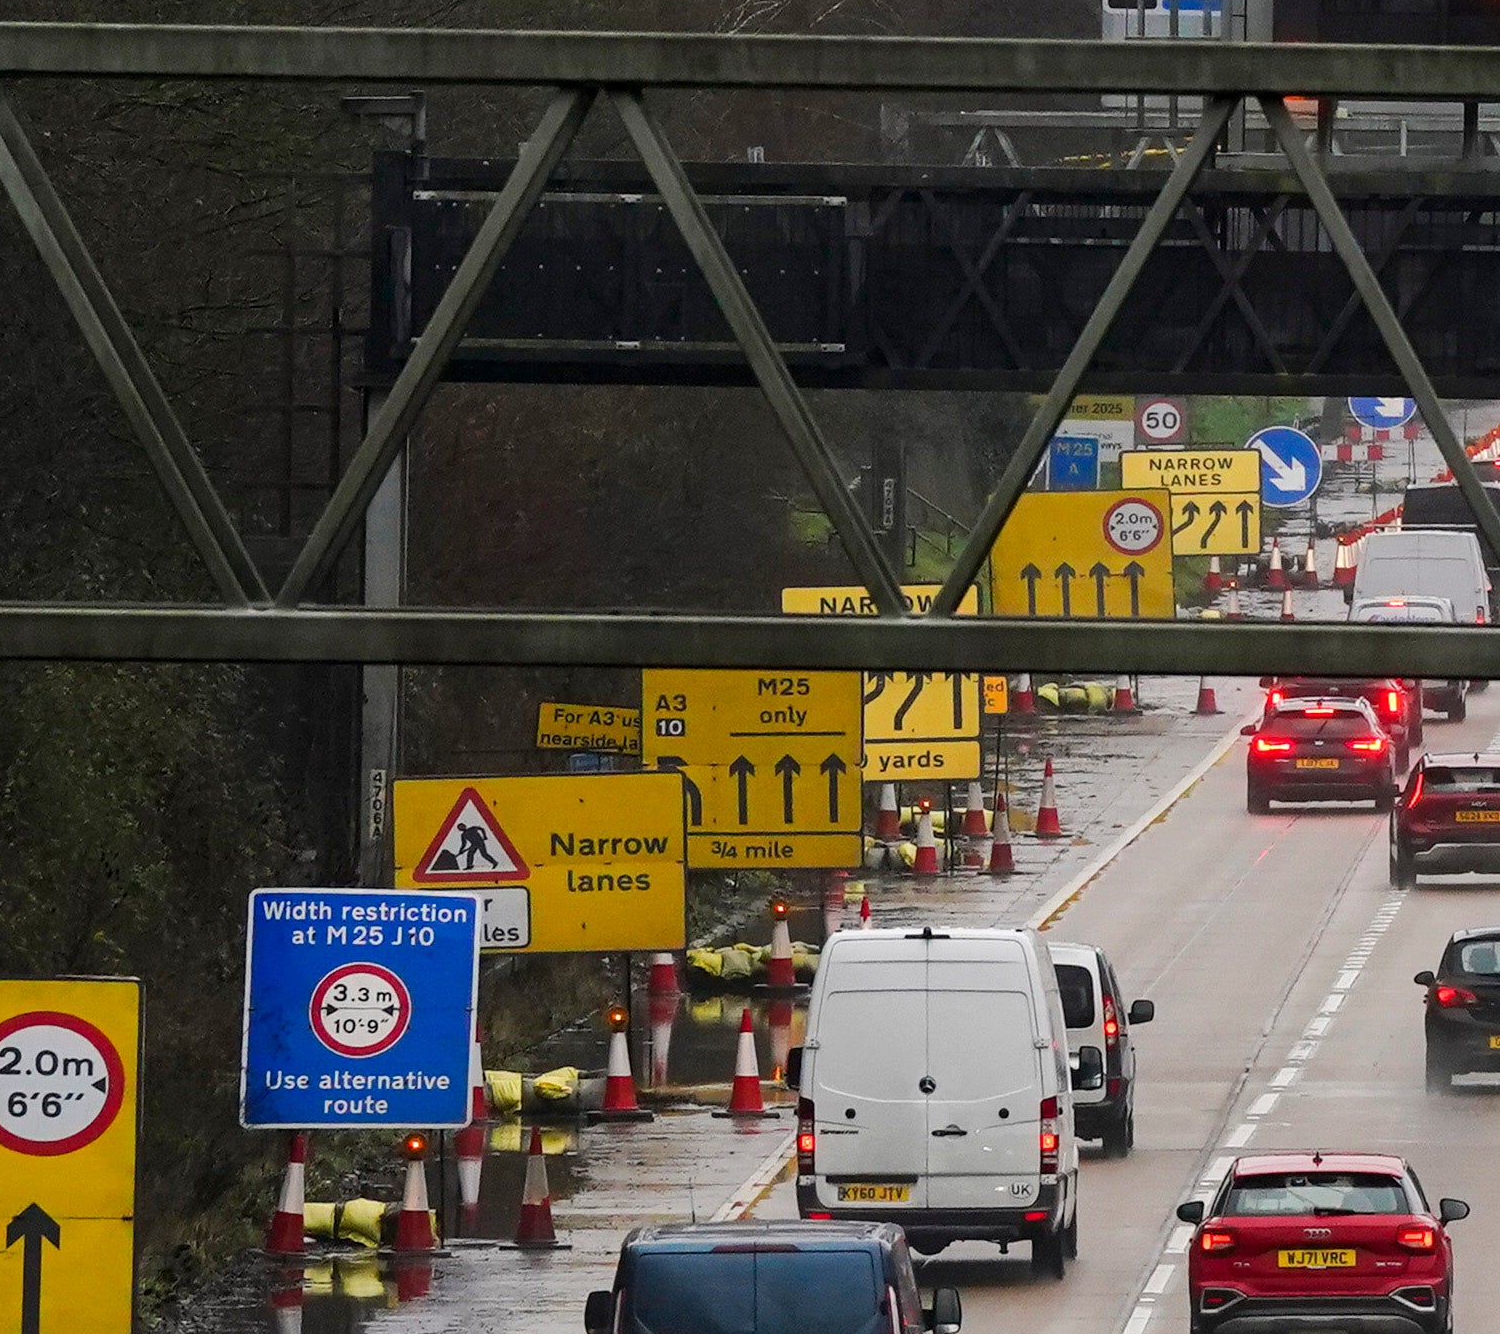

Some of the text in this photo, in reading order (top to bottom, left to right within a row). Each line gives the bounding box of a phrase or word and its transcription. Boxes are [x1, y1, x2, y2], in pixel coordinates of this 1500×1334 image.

[1091, 402, 1123, 414] 2025
[1145, 411, 1178, 430] 50
[1149, 457, 1234, 471] NARROW
[1160, 473, 1223, 487] LANES
[819, 595, 934, 614] NAROW
[757, 678, 810, 696] M25
[655, 694, 688, 712] A3
[553, 708, 640, 728] For A3 us
[759, 707, 807, 727] only
[658, 720, 684, 736] 10
[540, 732, 617, 749] nearside
[879, 750, 945, 770] yards
[372, 771, 383, 838] 4706A
[549, 832, 669, 856] Narrow
[745, 840, 794, 859] mile
[567, 869, 651, 893] lanes
[262, 900, 333, 921] Width
[341, 902, 468, 924] restriction
[291, 926, 317, 946] at
[265, 1069, 451, 1091] Use alternative
[323, 1097, 389, 1115] route
[1011, 1185, 1030, 1196] UK
[1286, 1251, 1348, 1265] WJ71 VRC
